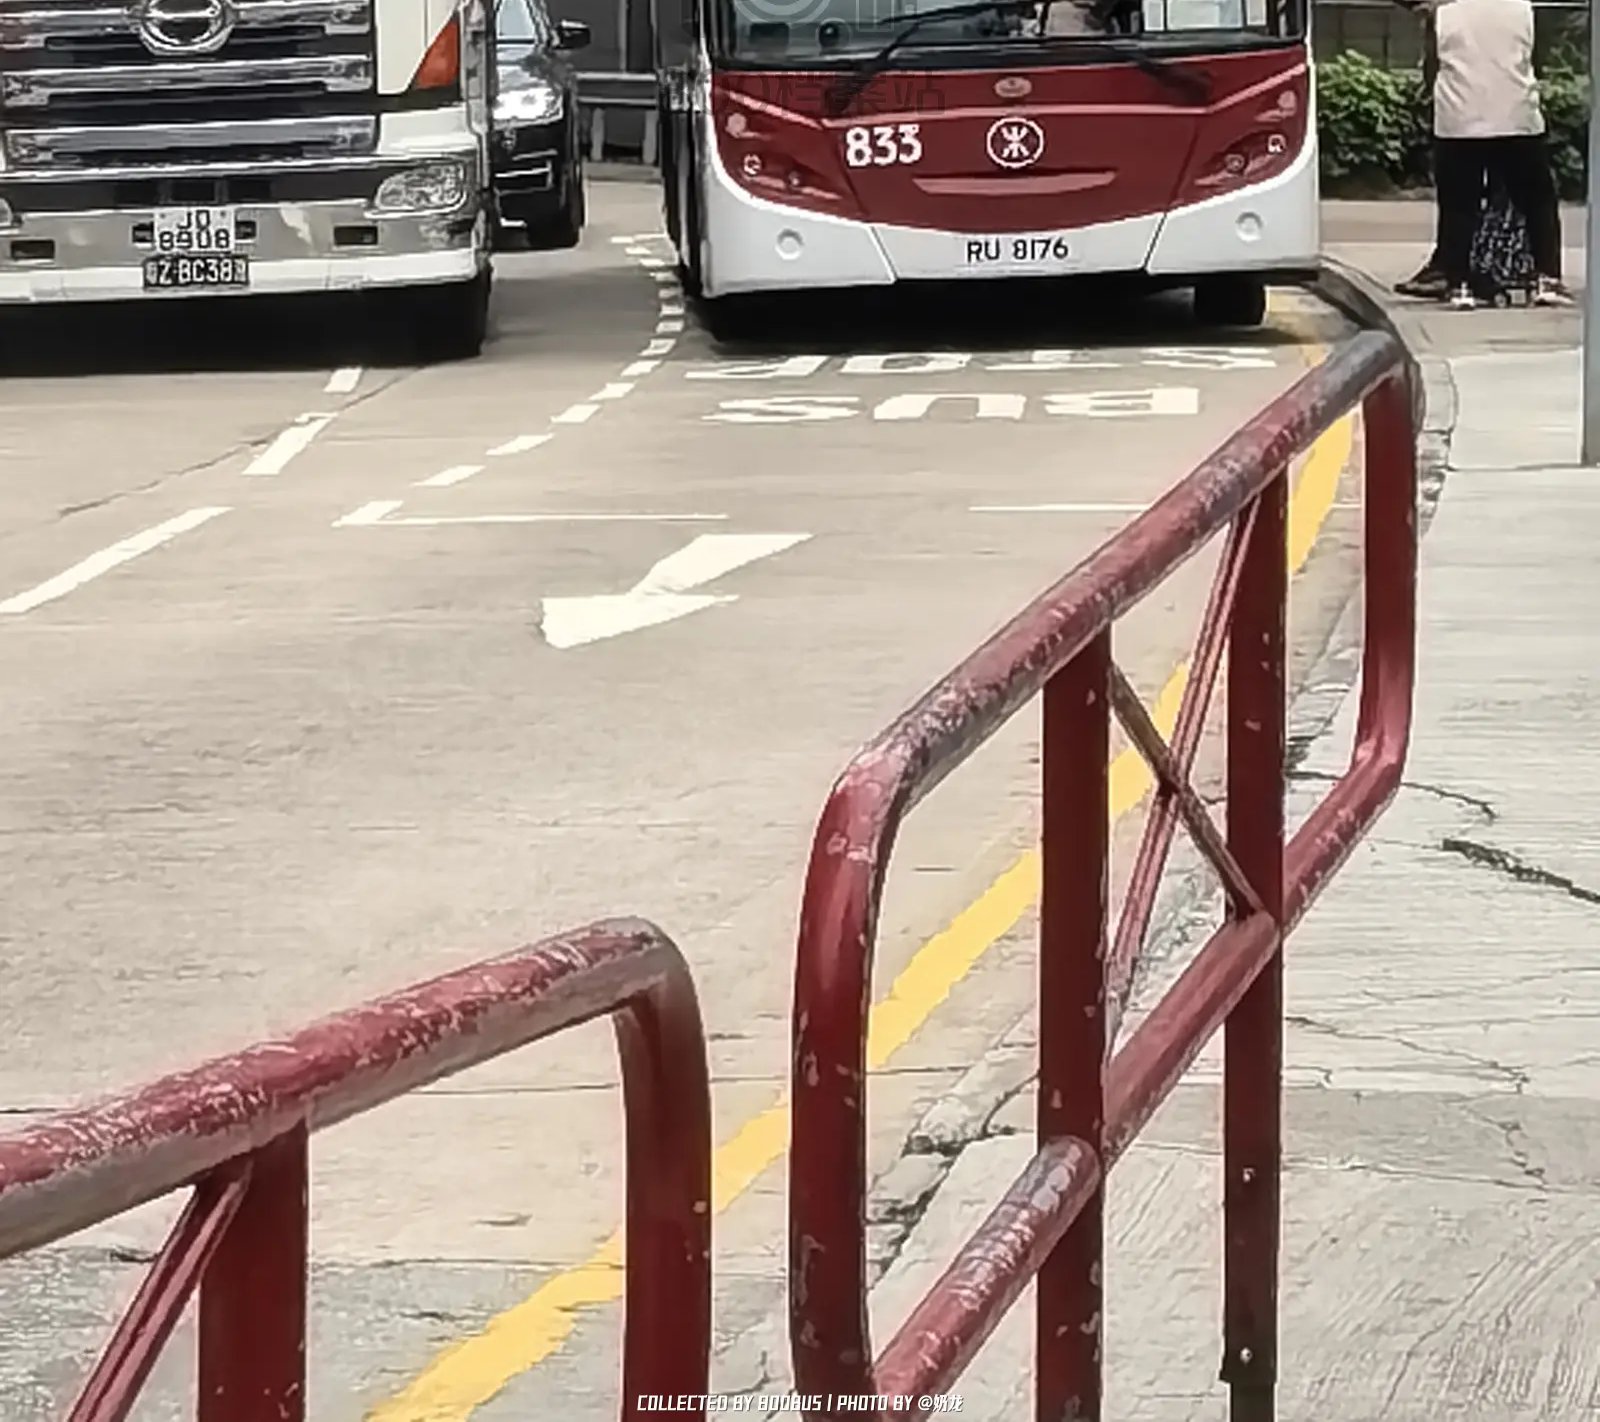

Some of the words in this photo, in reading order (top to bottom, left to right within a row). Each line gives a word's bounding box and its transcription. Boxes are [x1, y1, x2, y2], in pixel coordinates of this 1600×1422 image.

[846, 124, 922, 167] 833
[159, 227, 230, 251] 8908
[967, 239, 1000, 264] RU
[1013, 237, 1069, 261] 8176
[702, 386, 1200, 424] BUS
